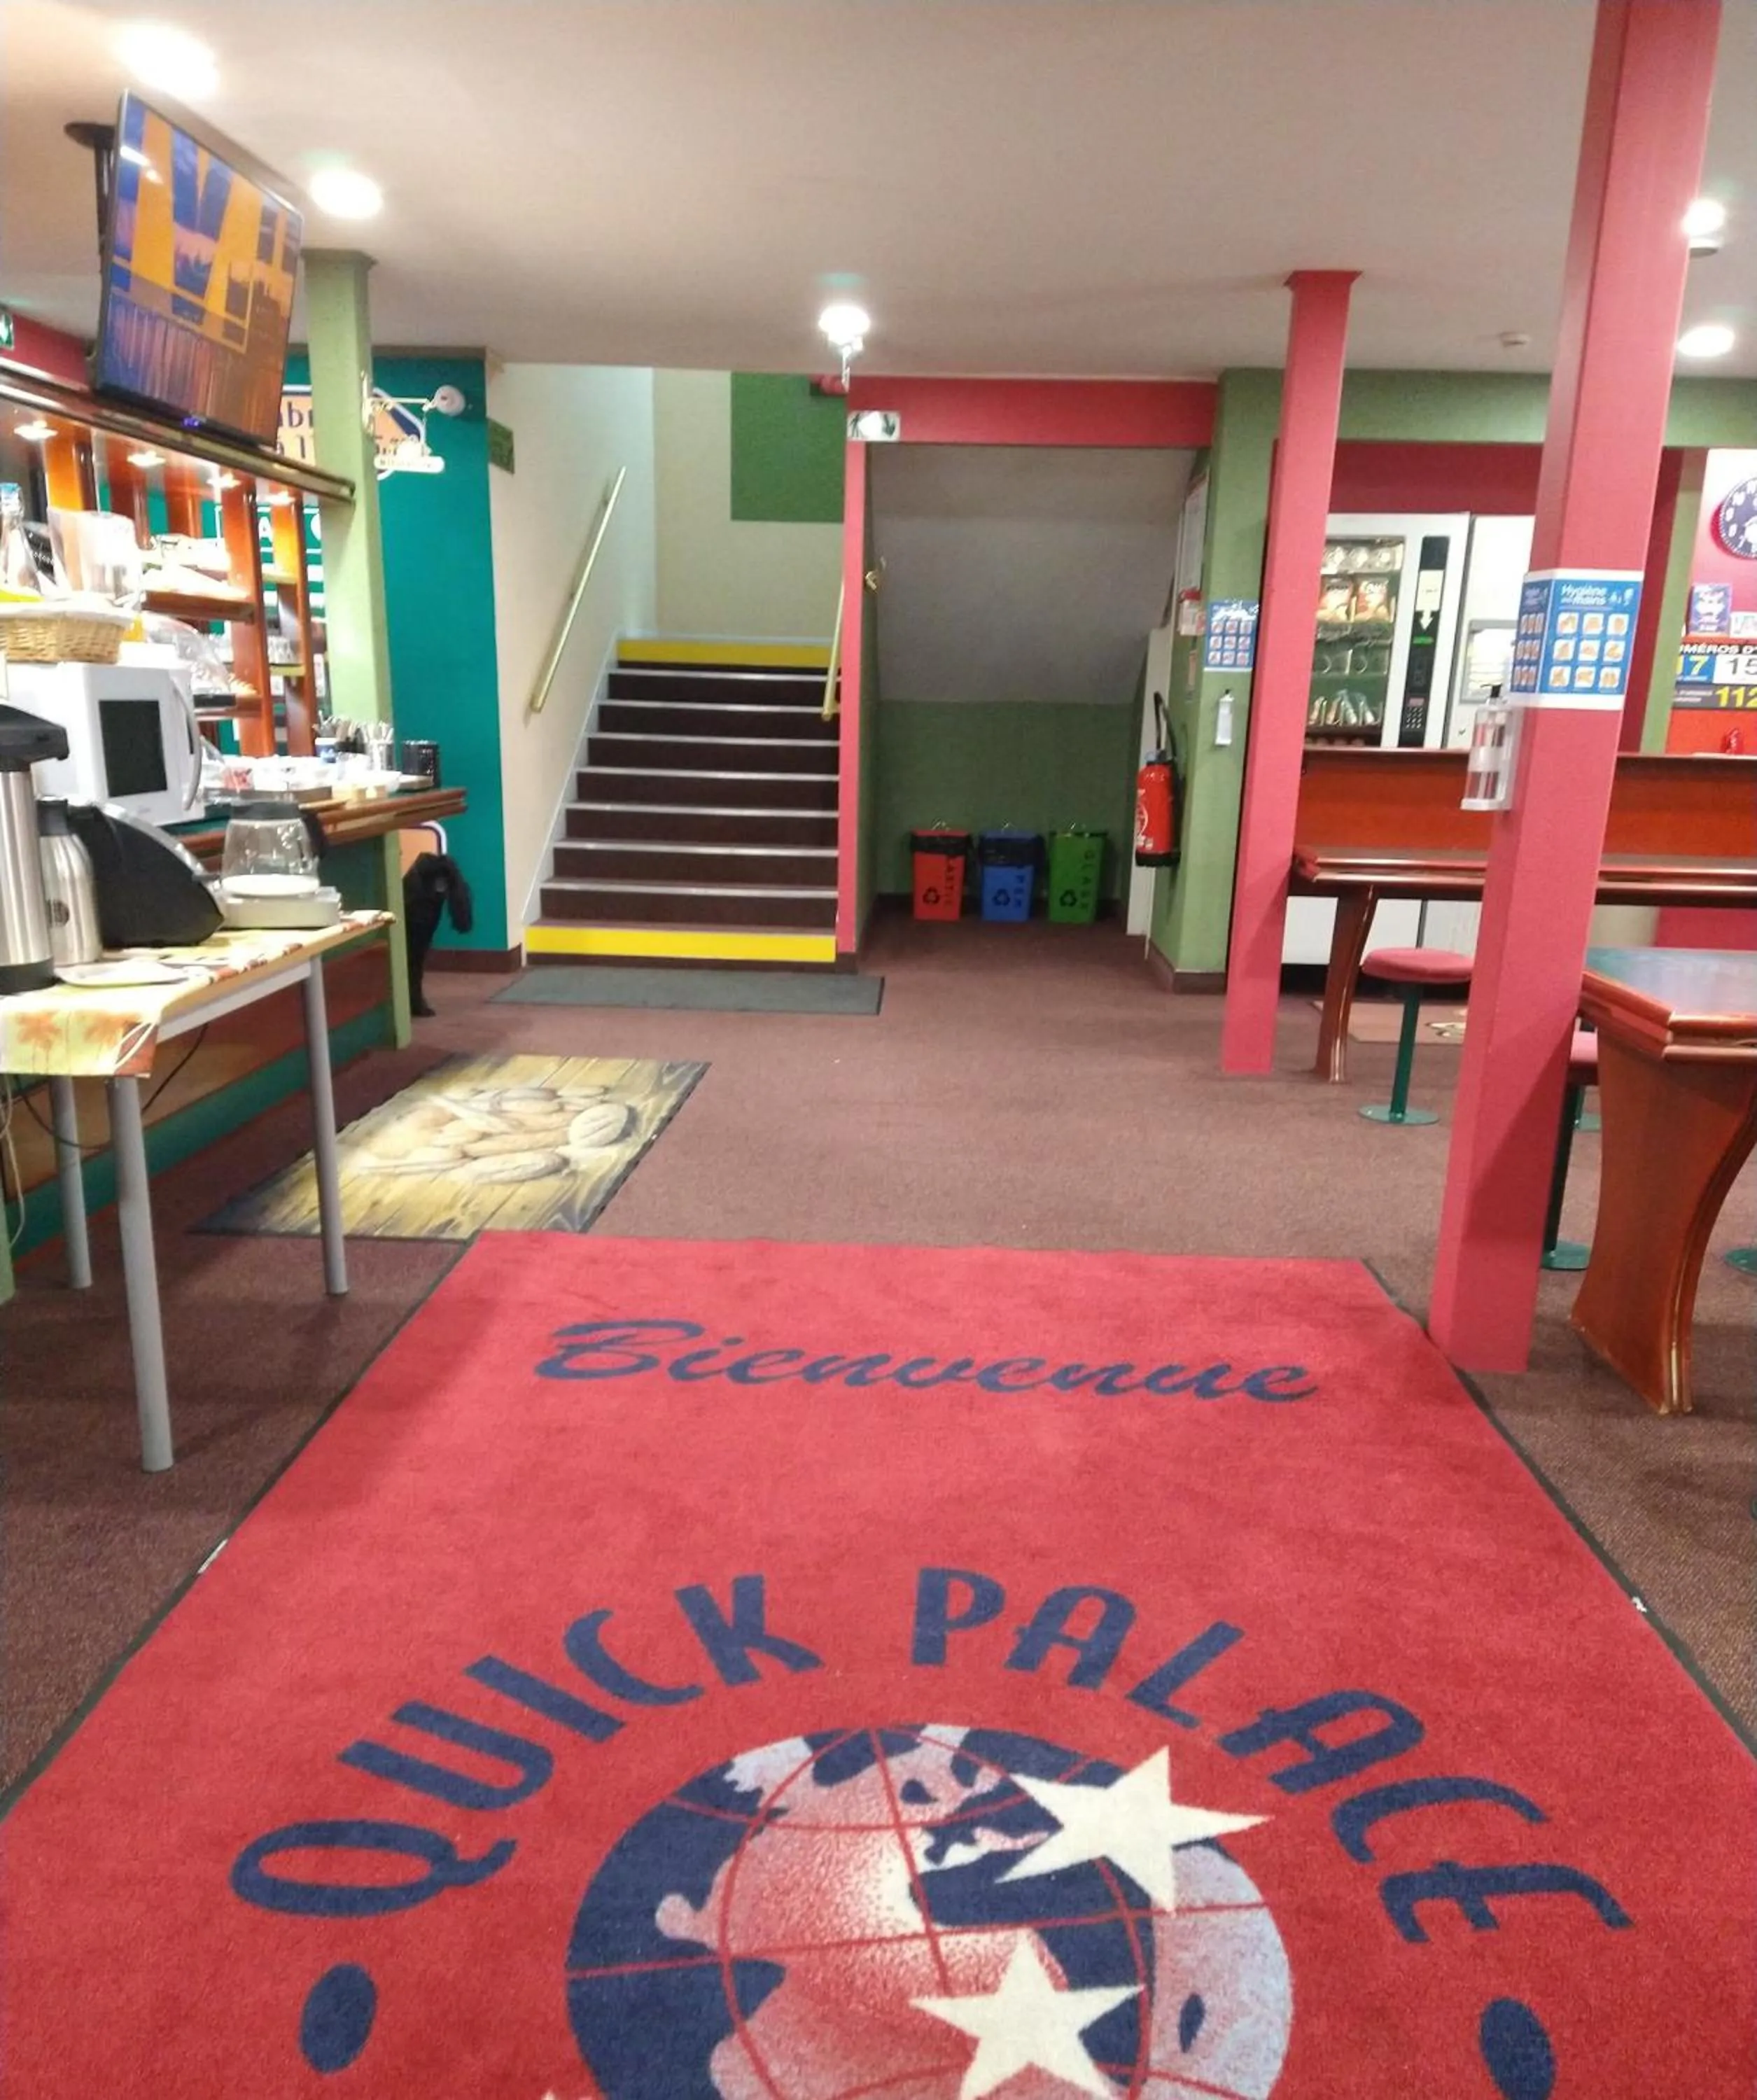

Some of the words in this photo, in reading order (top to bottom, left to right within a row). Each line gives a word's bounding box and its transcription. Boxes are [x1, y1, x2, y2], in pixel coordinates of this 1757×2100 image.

[1715, 686, 1757, 707] 112
[536, 1320, 1318, 1402] Bienvenue
[230, 1575, 820, 1917] QUICK
[912, 1568, 1632, 1943] PALACE
